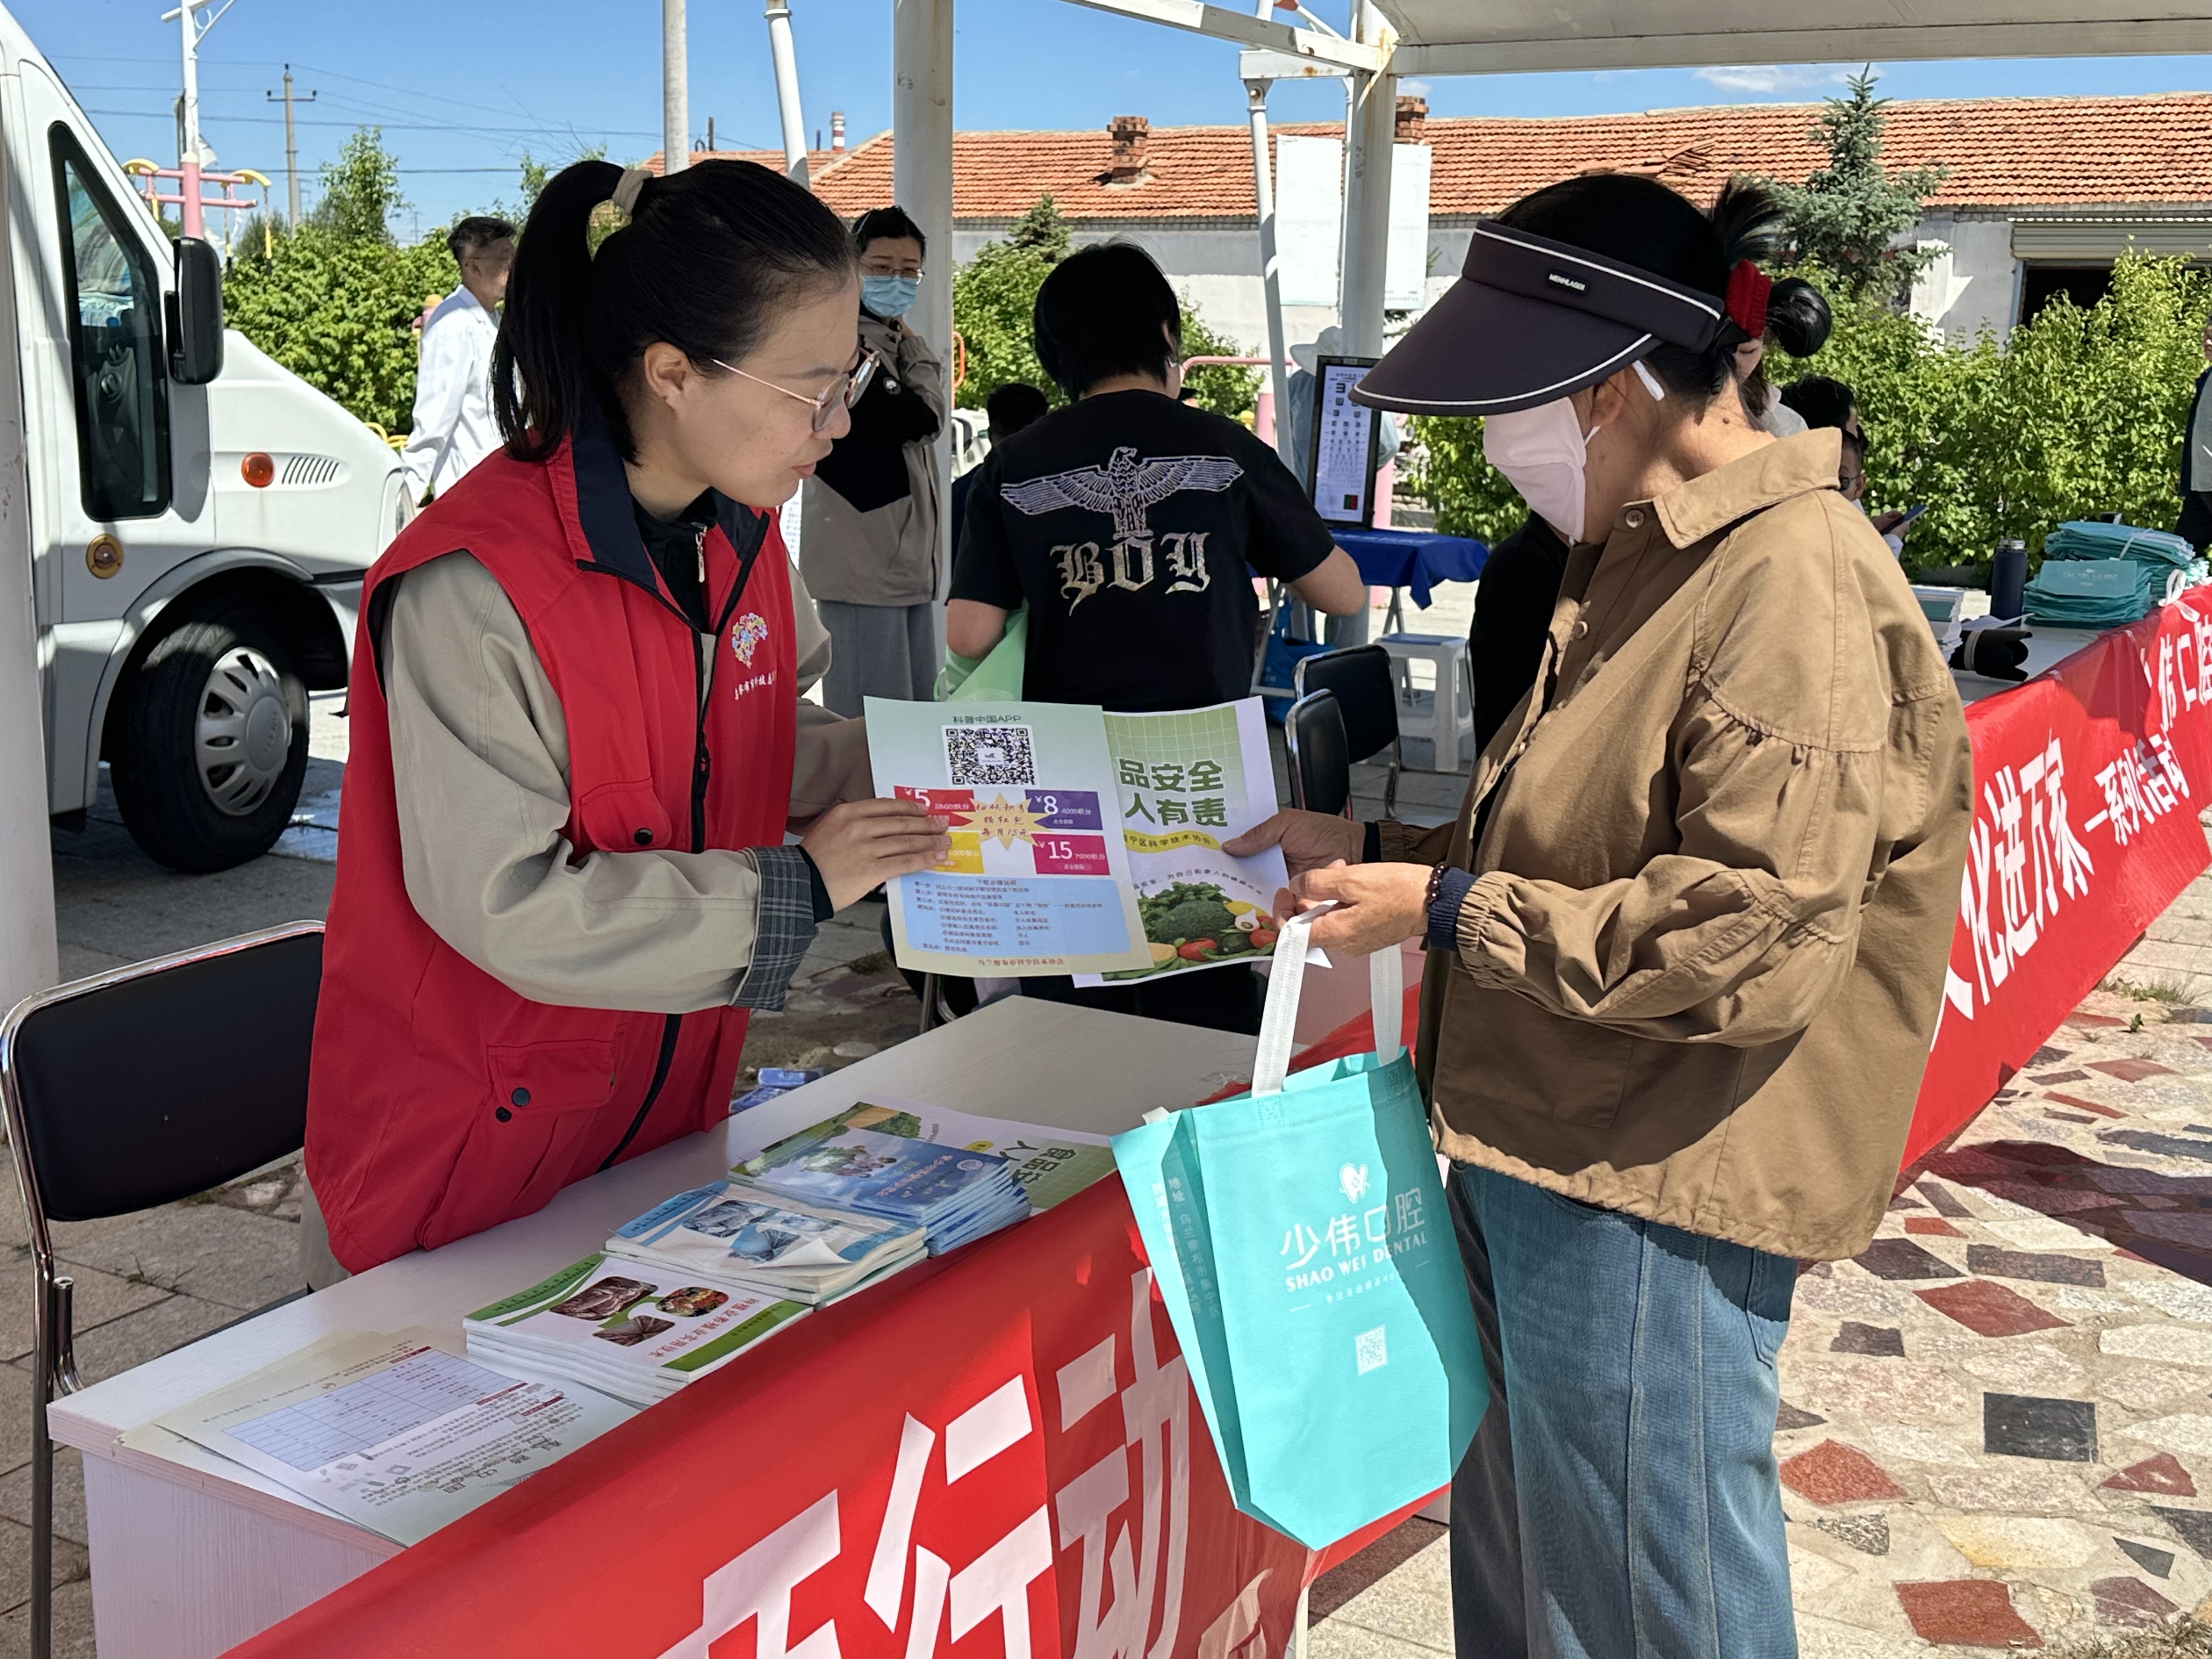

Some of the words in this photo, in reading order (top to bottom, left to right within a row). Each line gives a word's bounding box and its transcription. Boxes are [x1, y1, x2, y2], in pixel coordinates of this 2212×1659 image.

[1050, 532, 1212, 617] BOY
[2140, 614, 2212, 732] 伟口腔
[953, 715, 1021, 724] 科普中国APP
[1119, 758, 1224, 793] 品安全
[1125, 792, 1228, 827] 人有责
[1946, 727, 2095, 1020] 化进万家
[1279, 1187, 1425, 1271] 少伟口腔
[1285, 1266, 1334, 1293] SHAO
[1338, 1255, 1366, 1276] WEI
[1373, 1231, 1428, 1263] DENTAL
